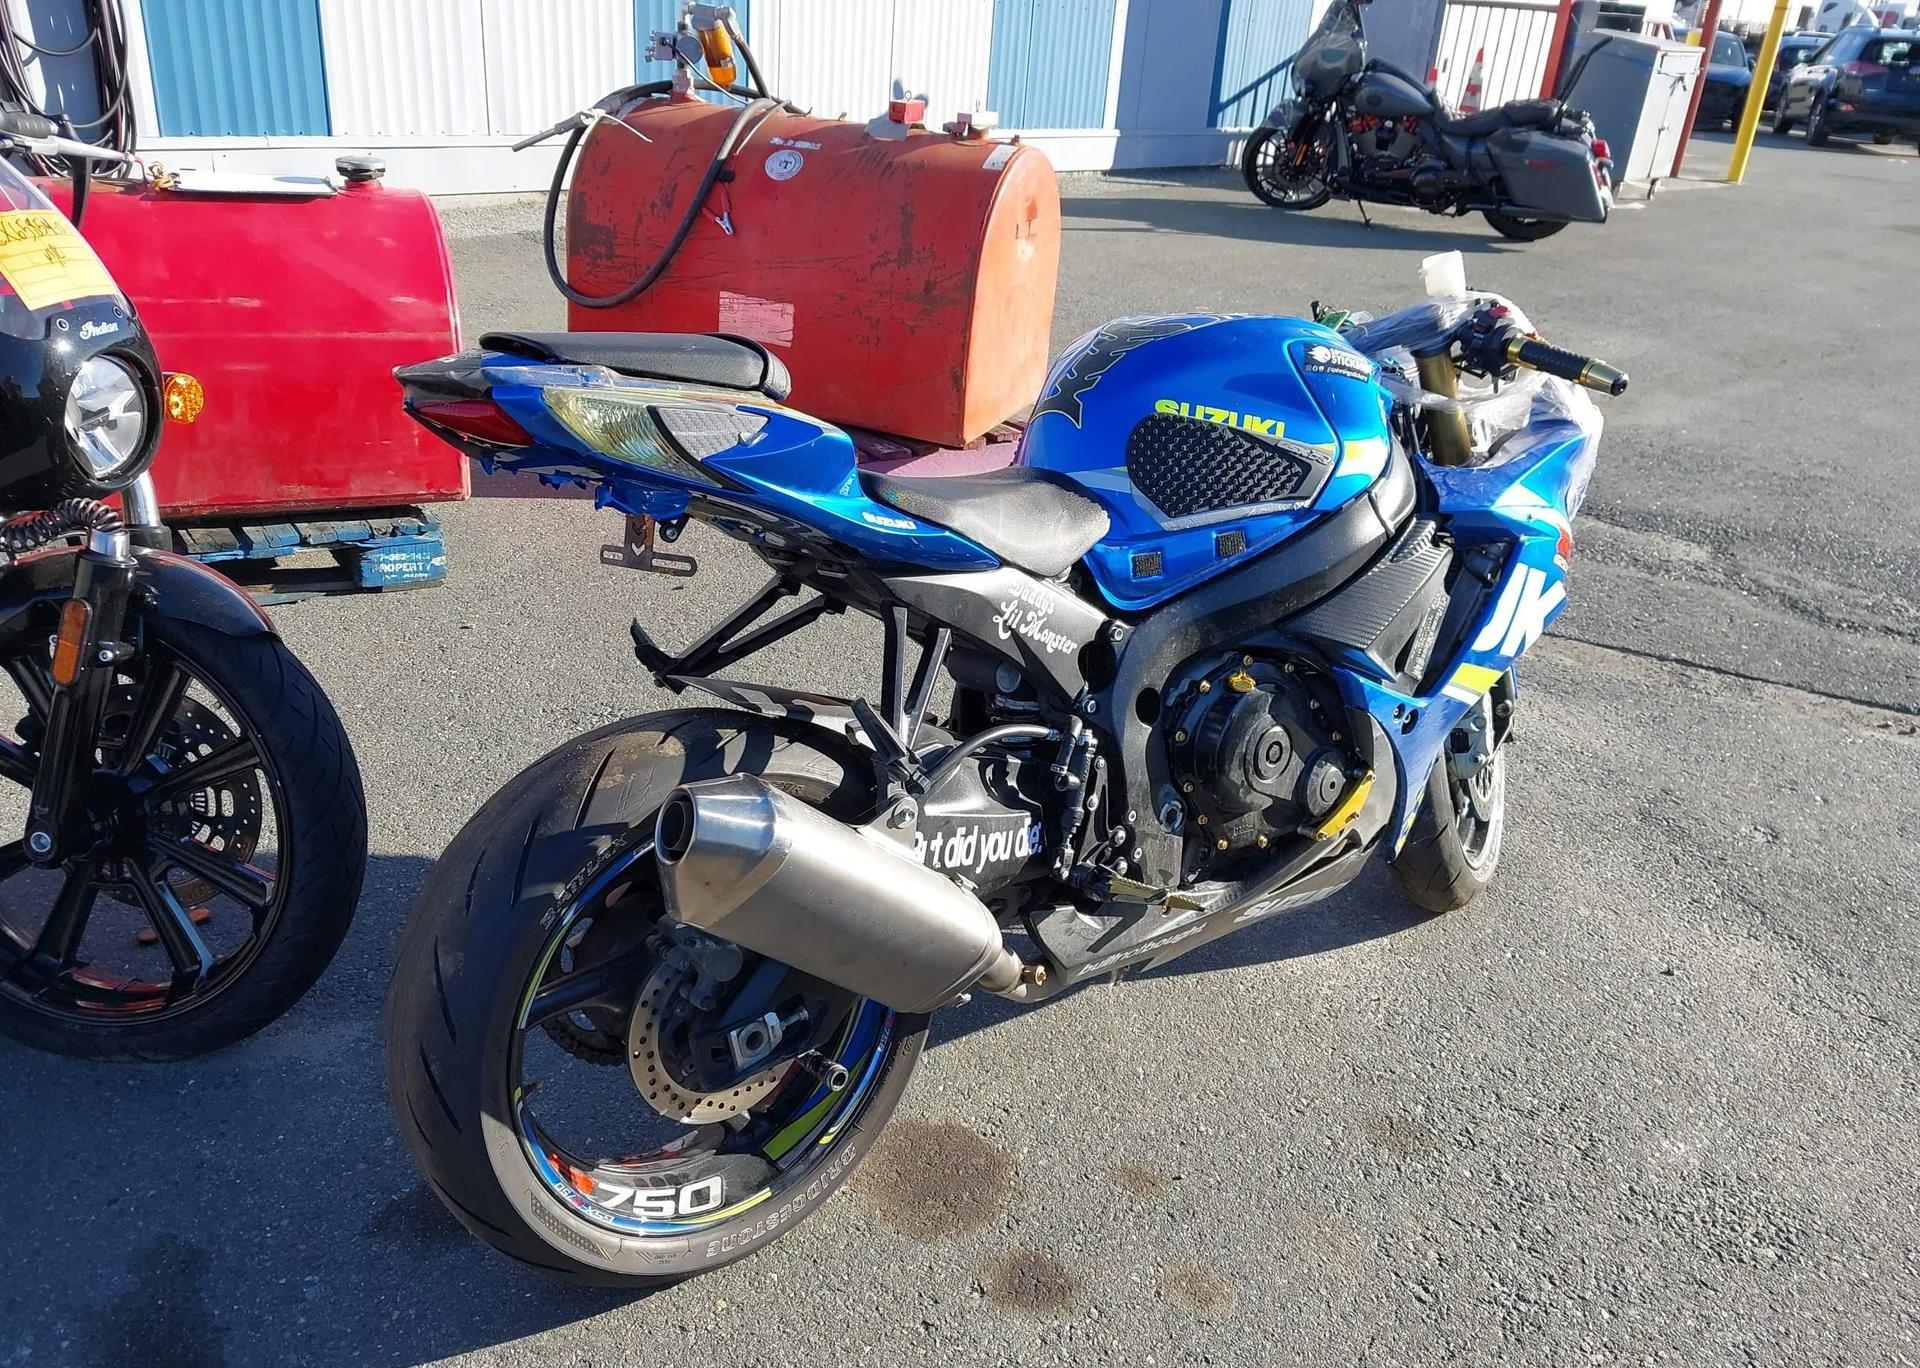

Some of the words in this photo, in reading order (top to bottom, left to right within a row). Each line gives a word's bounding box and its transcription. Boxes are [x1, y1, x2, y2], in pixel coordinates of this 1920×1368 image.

[80, 321, 118, 340] Indian
[1155, 399, 1285, 438] SUZUKI
[1008, 580, 1055, 616] Daddy's
[992, 599, 1023, 640] Lil
[1019, 610, 1078, 654] Monster
[944, 825, 979, 868] did
[975, 829, 1014, 874] you
[597, 1174, 725, 1219] 750
[705, 1142, 857, 1258] BRIDGESTONE
